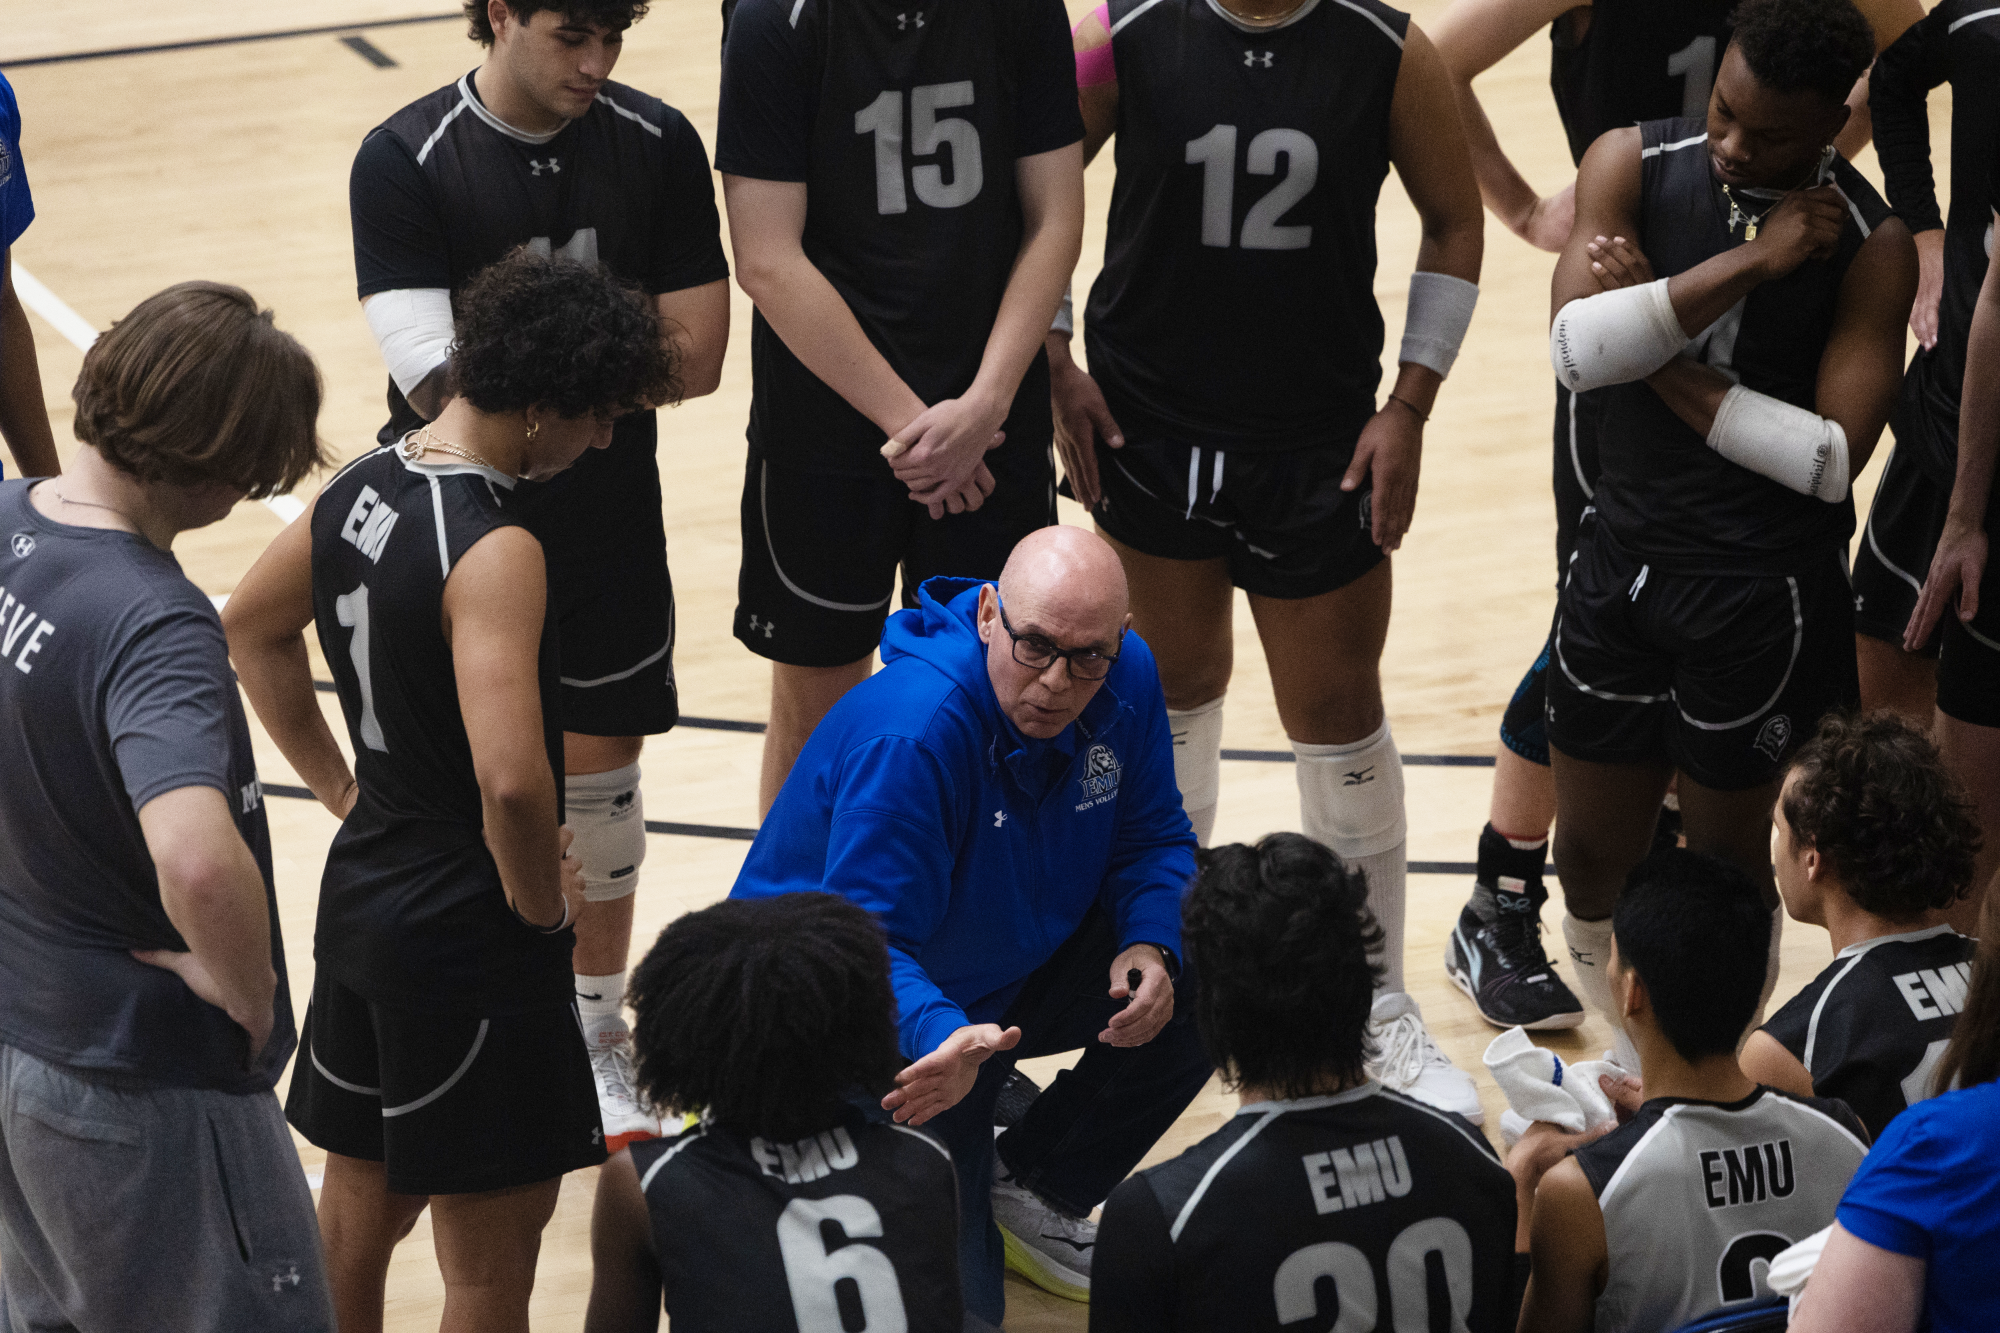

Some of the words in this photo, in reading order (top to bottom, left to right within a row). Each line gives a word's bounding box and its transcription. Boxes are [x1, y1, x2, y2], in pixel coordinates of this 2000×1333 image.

[854, 80, 984, 215] 15
[1185, 123, 1319, 249] 12
[335, 581, 389, 754] 1
[1075, 801, 1094, 812] MENS
[1083, 767, 1122, 798] EMU
[1892, 960, 1973, 1021] EM
[751, 1126, 859, 1184] EMU
[1302, 1135, 1413, 1215] EMU
[1699, 1139, 1795, 1210] EMU
[776, 1194, 908, 1333] 6
